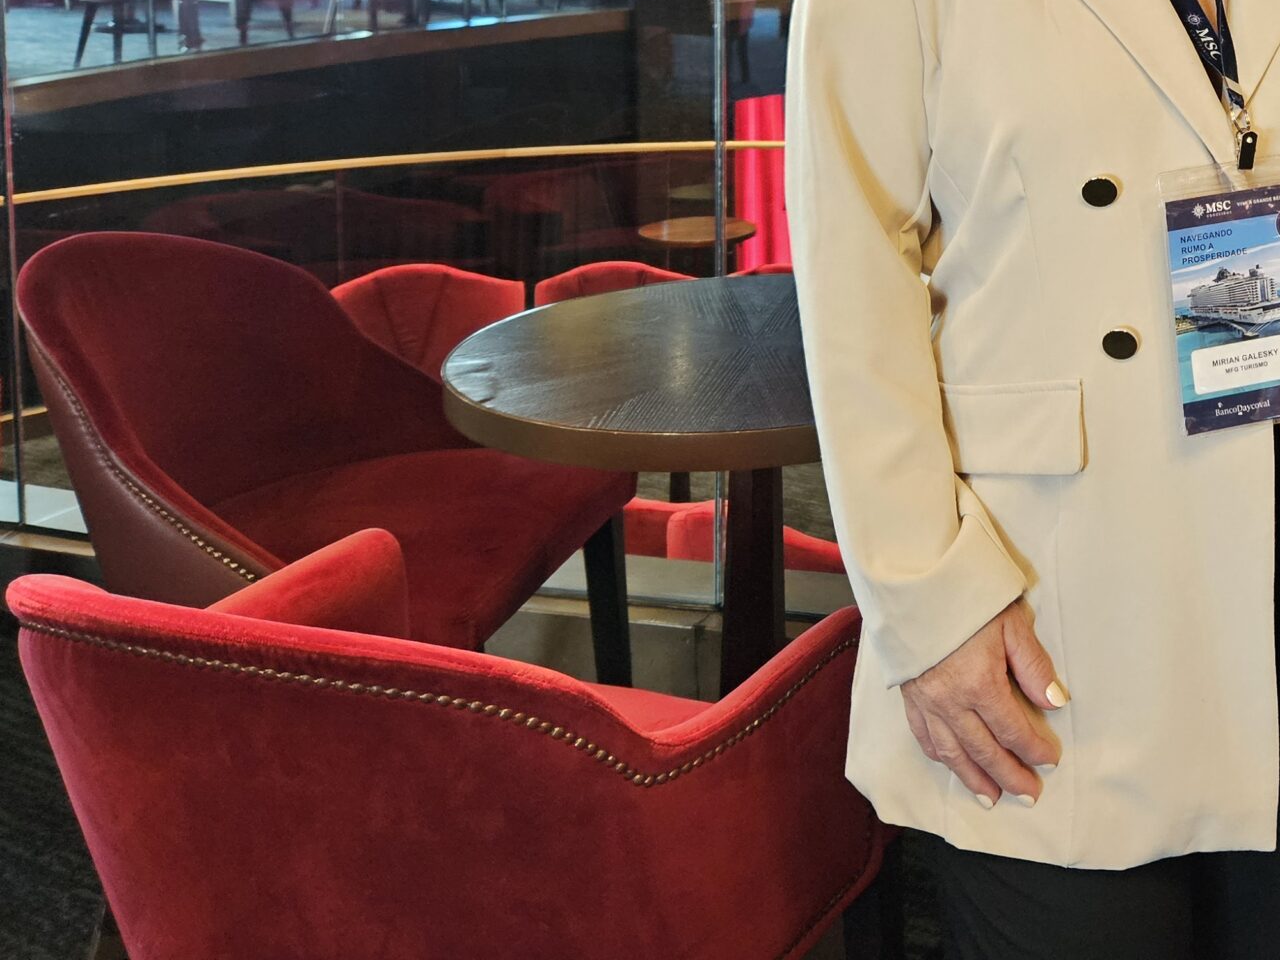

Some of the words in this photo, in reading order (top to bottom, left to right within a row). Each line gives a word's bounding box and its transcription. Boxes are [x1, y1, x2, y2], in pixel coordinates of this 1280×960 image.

[1195, 28, 1222, 61] MSC
[1205, 200, 1231, 214] MSC
[1180, 229, 1233, 244] NAVEGANDO
[1181, 244, 1206, 254] RUMO
[1182, 247, 1248, 265] PROSPERIDADE
[1212, 356, 1240, 367] MIRIAN
[1241, 348, 1279, 362] GALESKY
[1240, 361, 1268, 371] TURISMO
